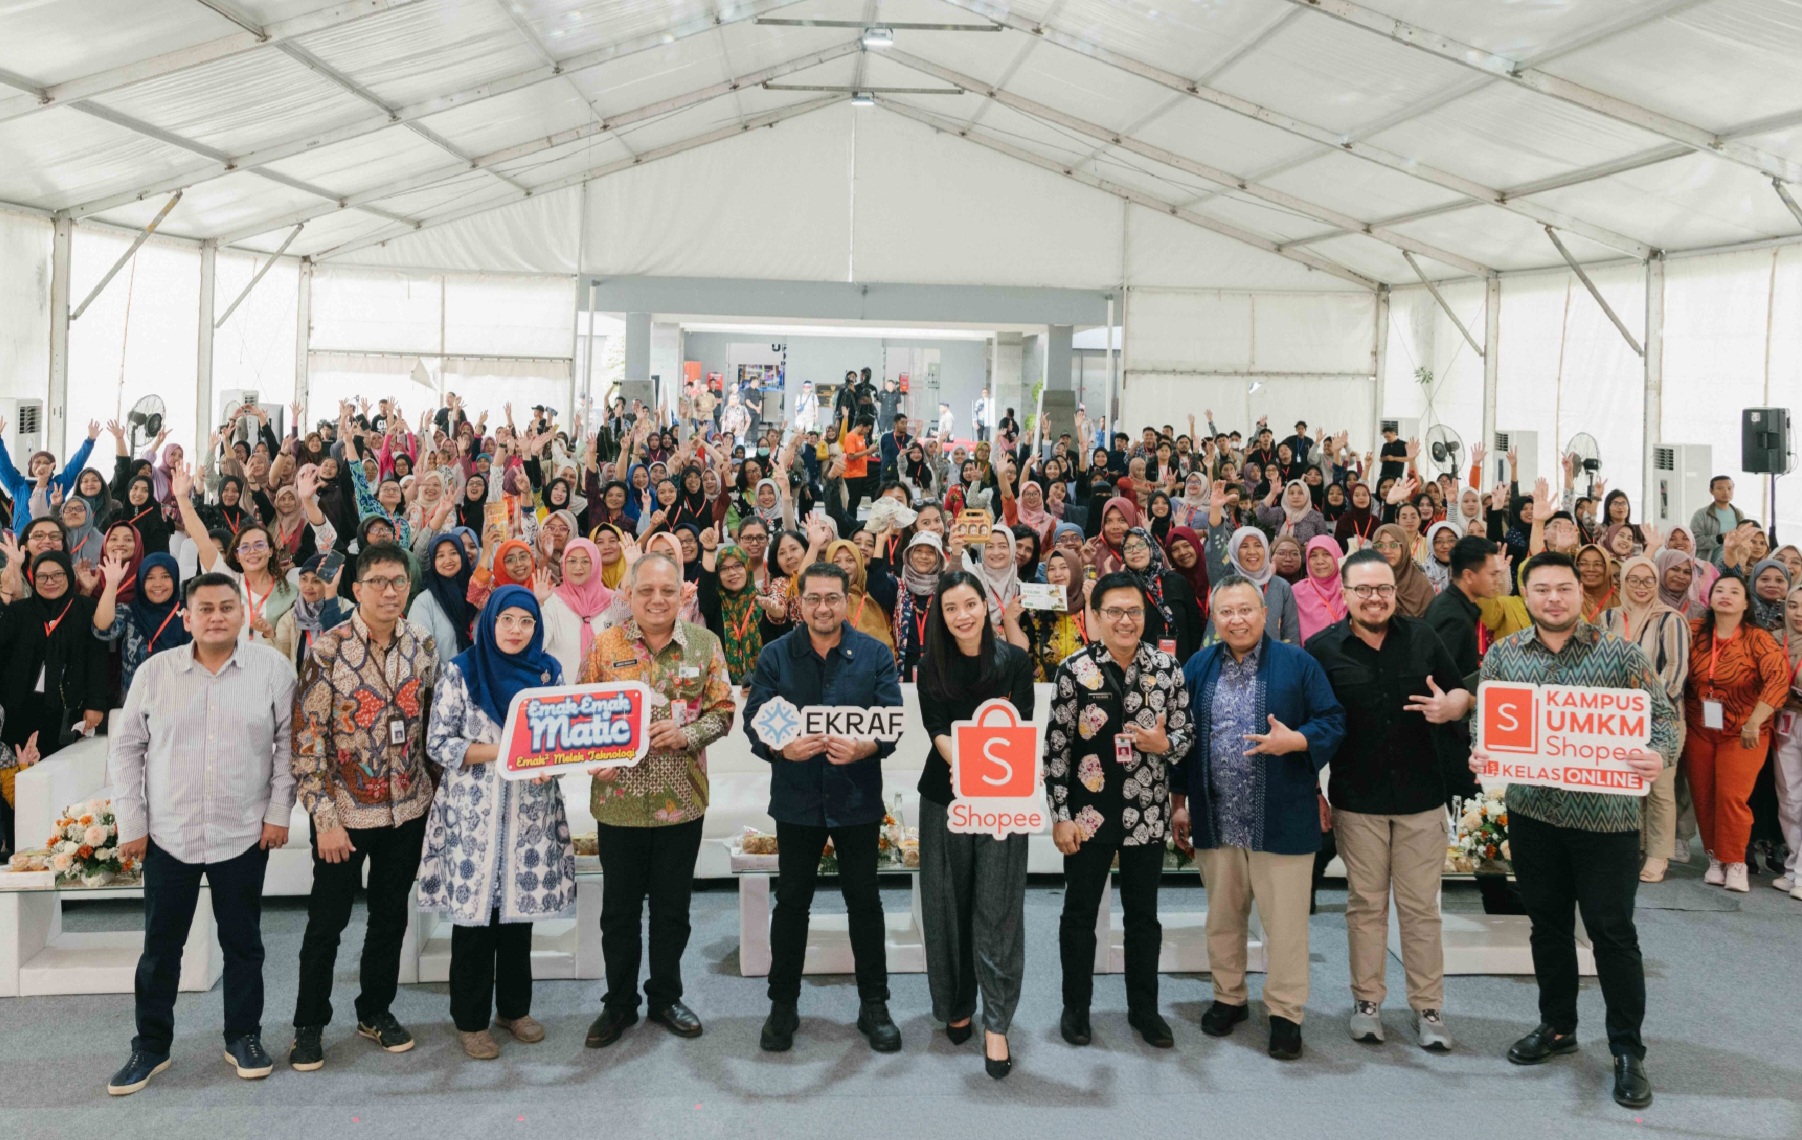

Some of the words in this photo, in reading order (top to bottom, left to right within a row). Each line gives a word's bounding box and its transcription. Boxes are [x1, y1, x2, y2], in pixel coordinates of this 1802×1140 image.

[1546, 690, 1644, 712] KAMPUS
[806, 712, 904, 734] EKRAF
[1497, 703, 1519, 731] S
[1546, 710, 1644, 737] UMKM
[529, 711, 631, 752] Matic
[554, 752, 585, 764] Melek
[588, 748, 635, 761] Teknologi
[981, 736, 1013, 786] S
[1503, 764, 1561, 781] KELAS
[1567, 769, 1640, 788] ONLINE
[952, 804, 1042, 834] Shopee
